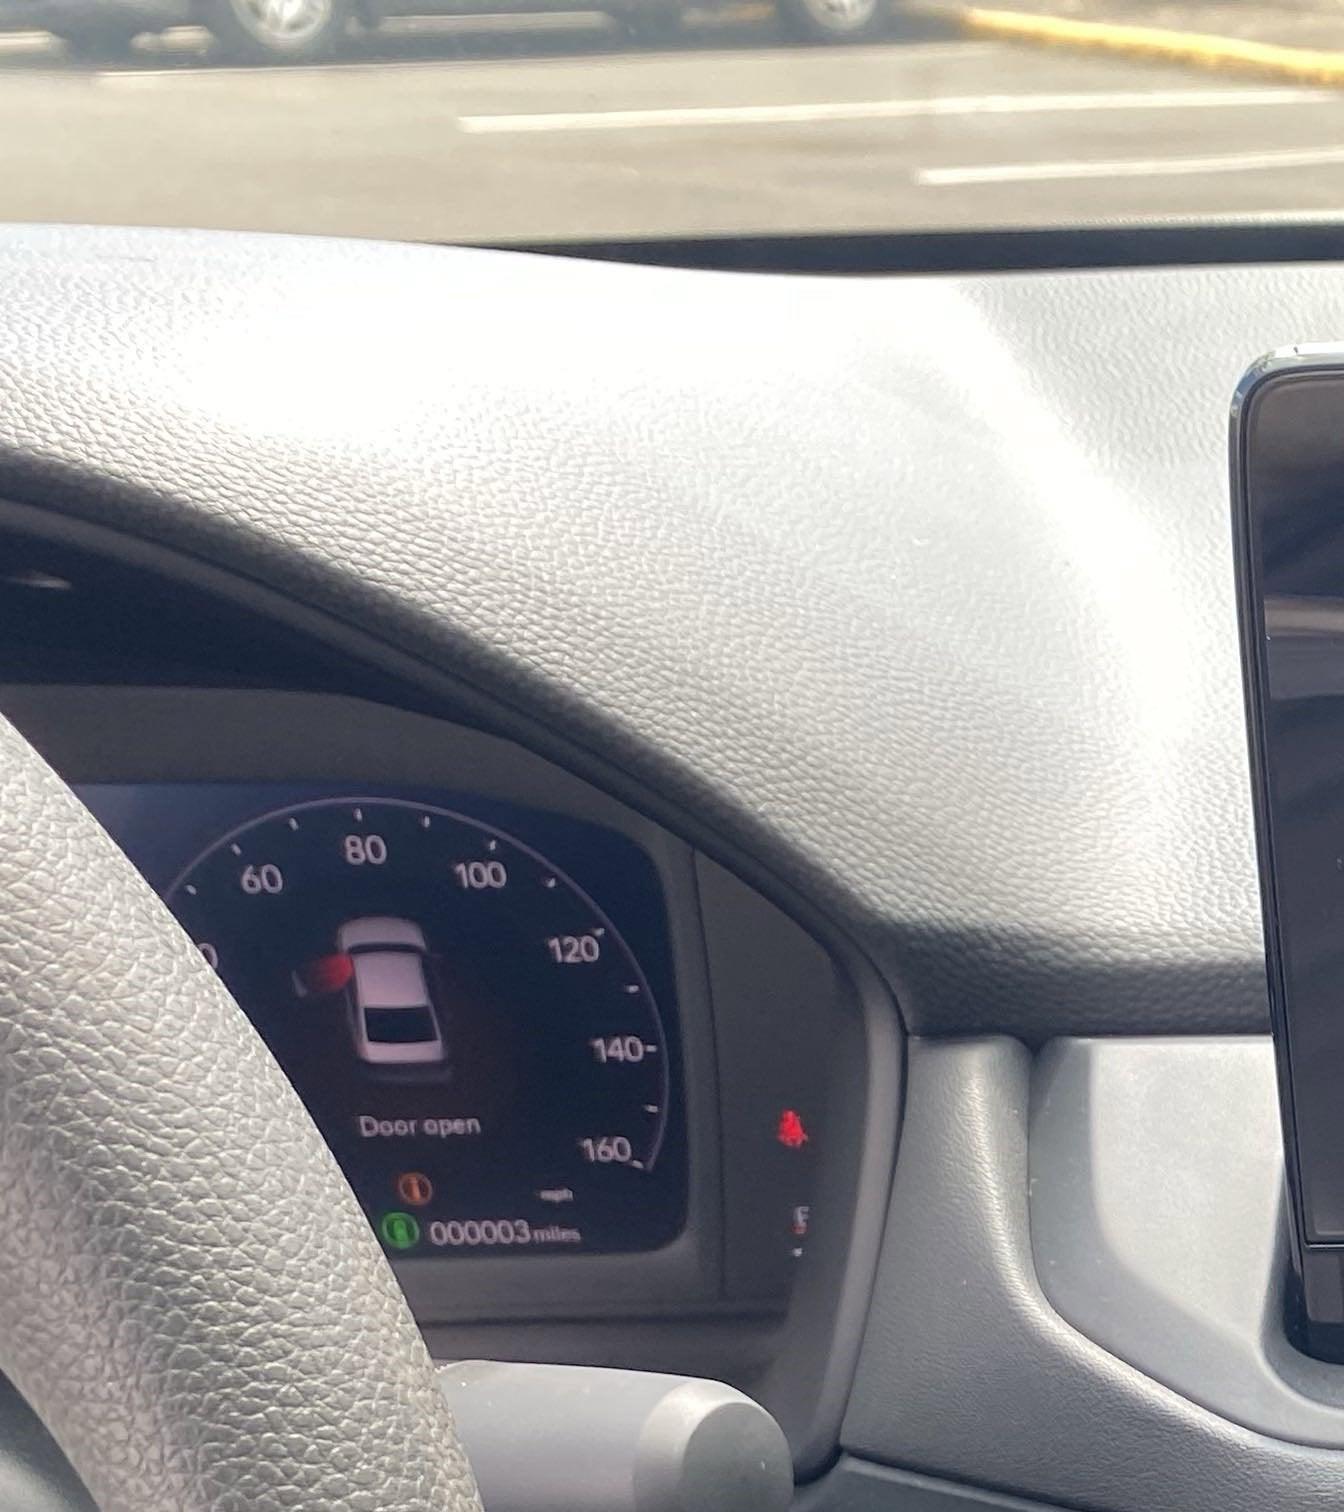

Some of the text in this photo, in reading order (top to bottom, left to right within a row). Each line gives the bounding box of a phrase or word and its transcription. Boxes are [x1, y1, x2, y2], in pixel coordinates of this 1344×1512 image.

[345, 834, 387, 864] 80
[241, 864, 283, 894] 60
[455, 860, 507, 888] 100
[548, 936, 600, 964] 120
[594, 1036, 645, 1064] 140
[360, 1113, 481, 1142] Door open
[583, 1136, 632, 1163] 160
[430, 1219, 531, 1246] 000003
